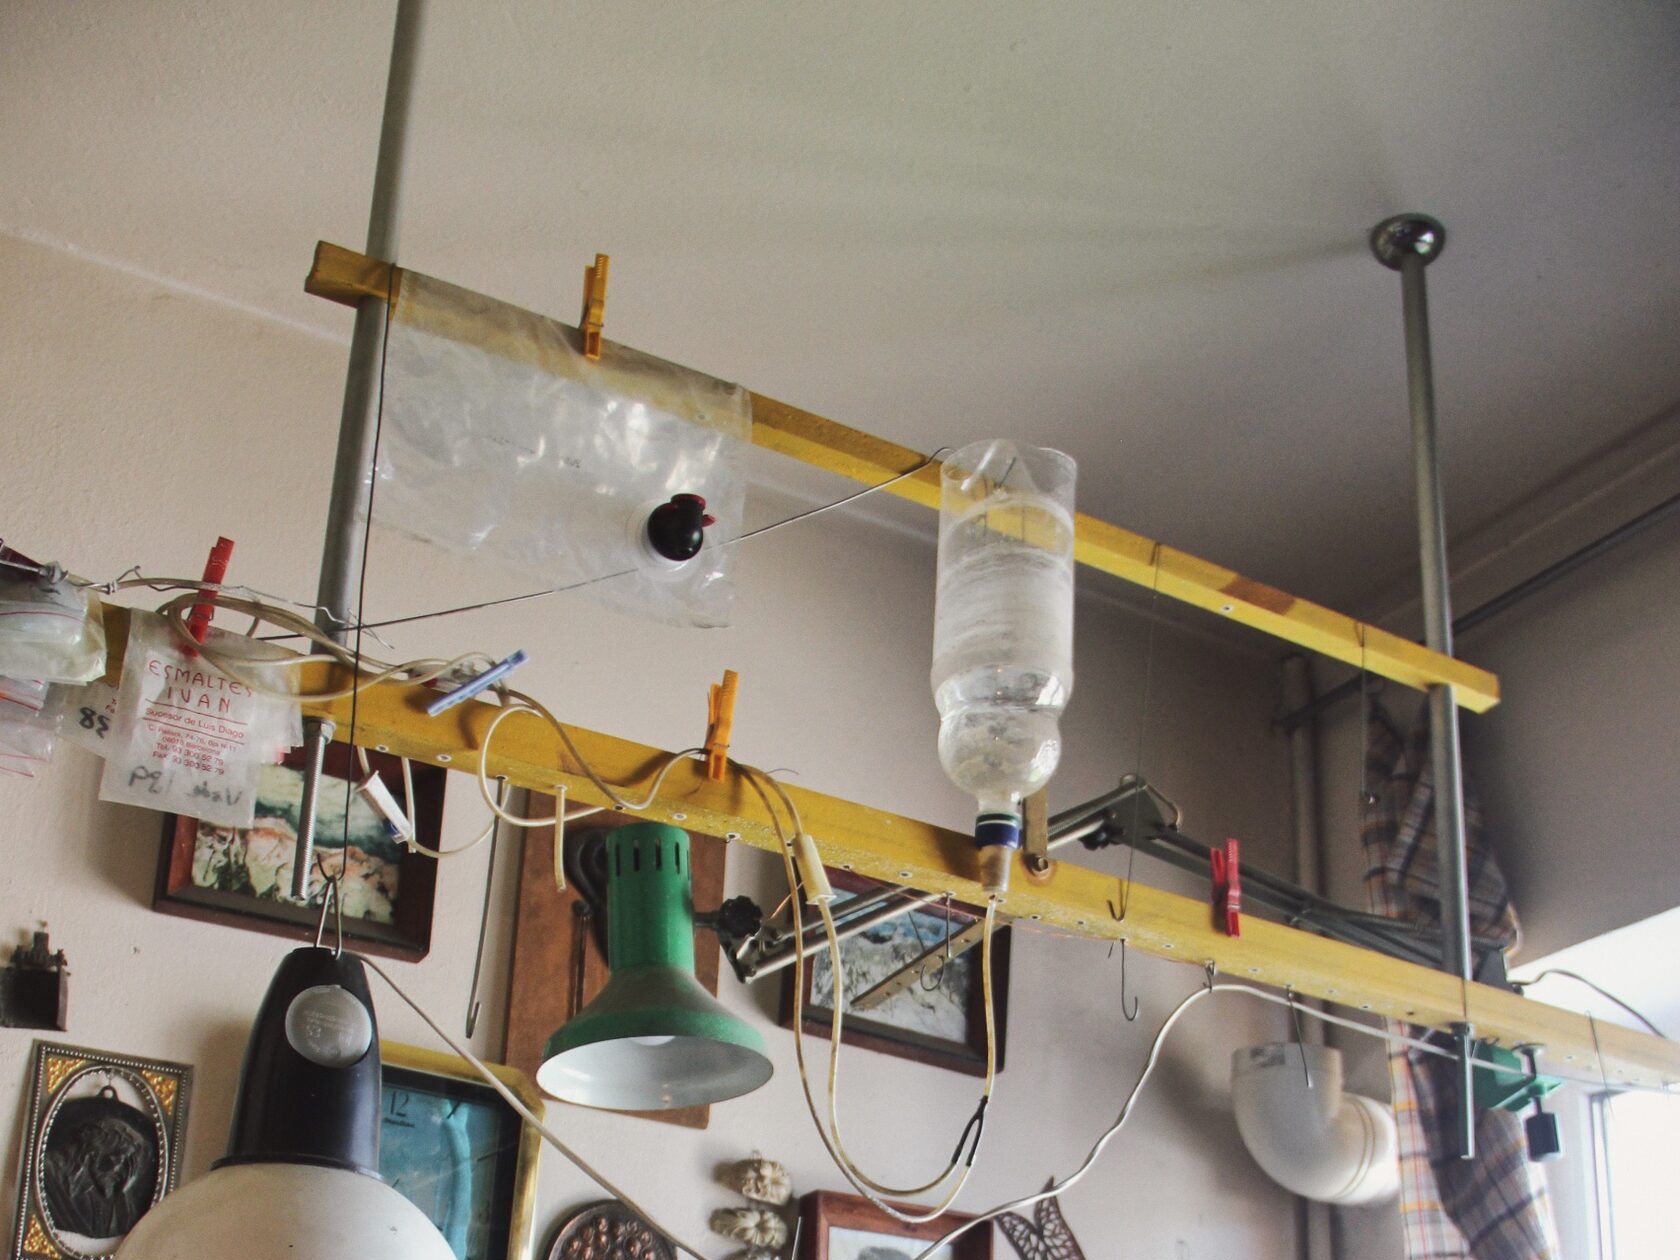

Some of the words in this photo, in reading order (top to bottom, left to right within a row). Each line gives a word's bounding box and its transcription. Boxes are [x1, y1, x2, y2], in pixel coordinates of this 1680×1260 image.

[149, 660, 252, 697] ESMALTES
[167, 686, 230, 713] IVAN
[184, 718, 196, 726] de
[198, 720, 216, 731] Luis
[184, 749, 200, 759] 300
[184, 759, 200, 769] 300
[390, 1090, 409, 1117] 12
